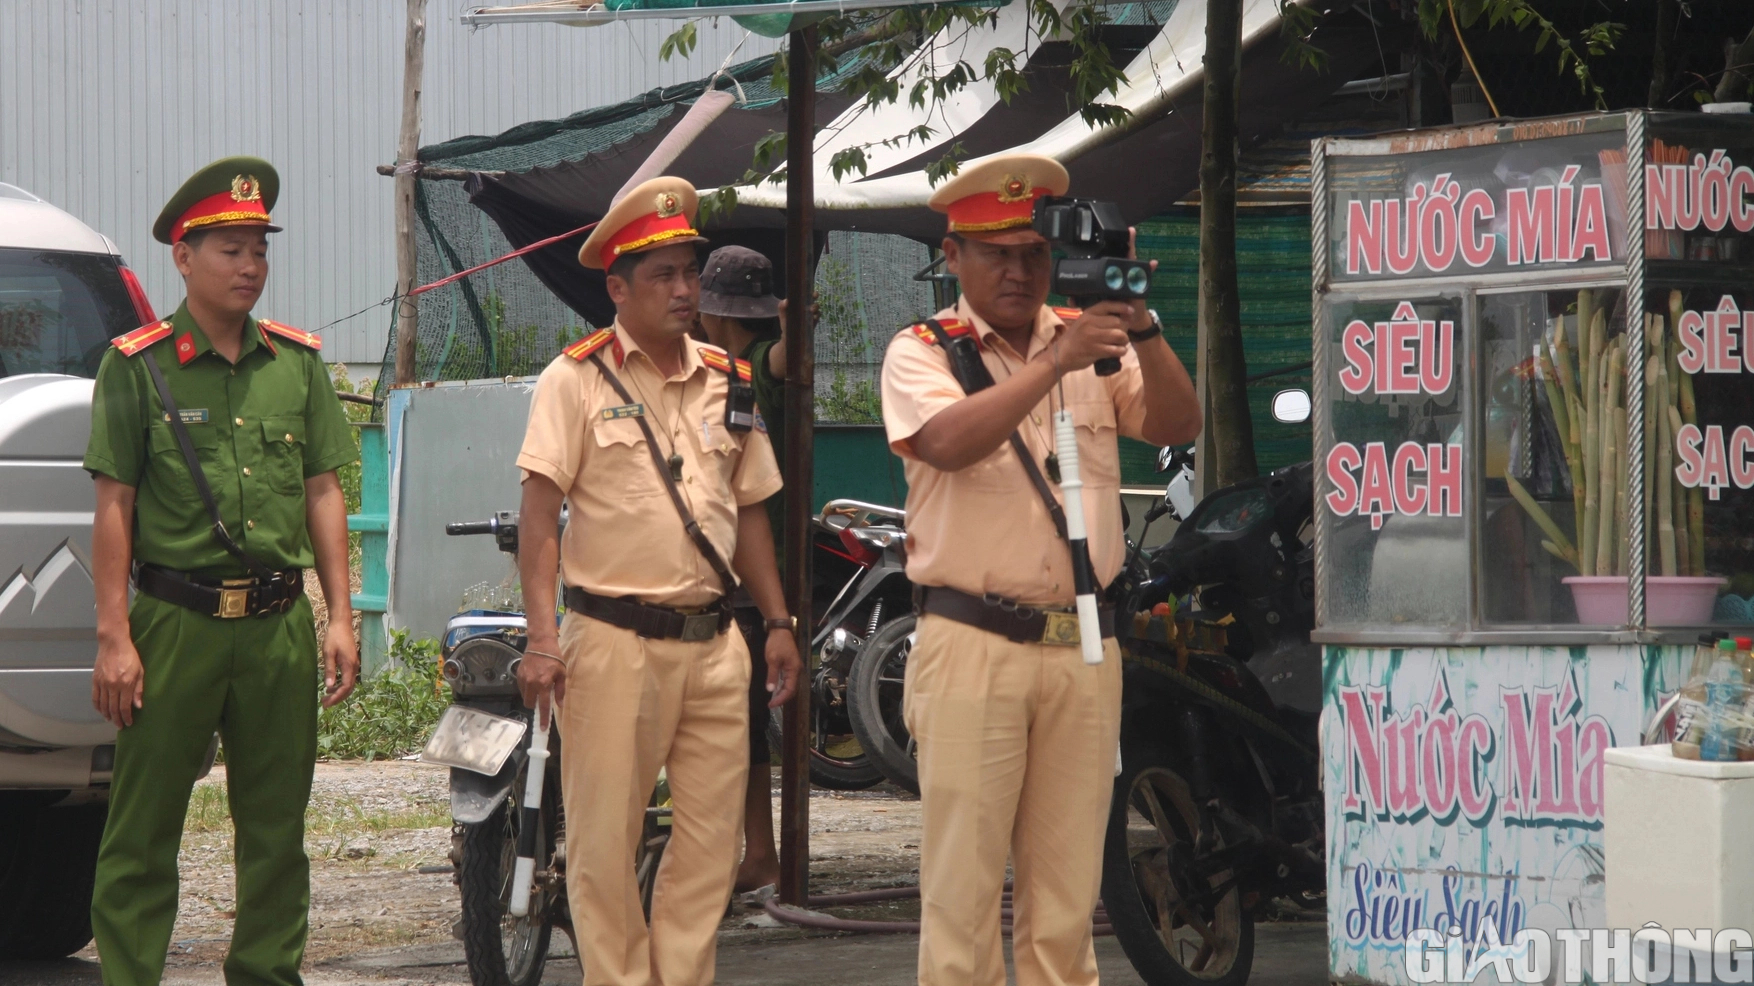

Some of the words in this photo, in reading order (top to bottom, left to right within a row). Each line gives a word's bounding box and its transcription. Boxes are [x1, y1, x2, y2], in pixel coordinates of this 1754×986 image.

[1347, 172, 1495, 275] NƯỚC
[1507, 164, 1611, 265] MÍA
[1645, 149, 1754, 232] NƯỚC
[1339, 301, 1454, 394] SIÊU
[1325, 441, 1463, 530] SẠCH
[1338, 660, 1493, 822] Nước
[1499, 659, 1605, 824] Mía
[1346, 862, 1426, 941] Siêu
[1433, 865, 1526, 968] Sạch
